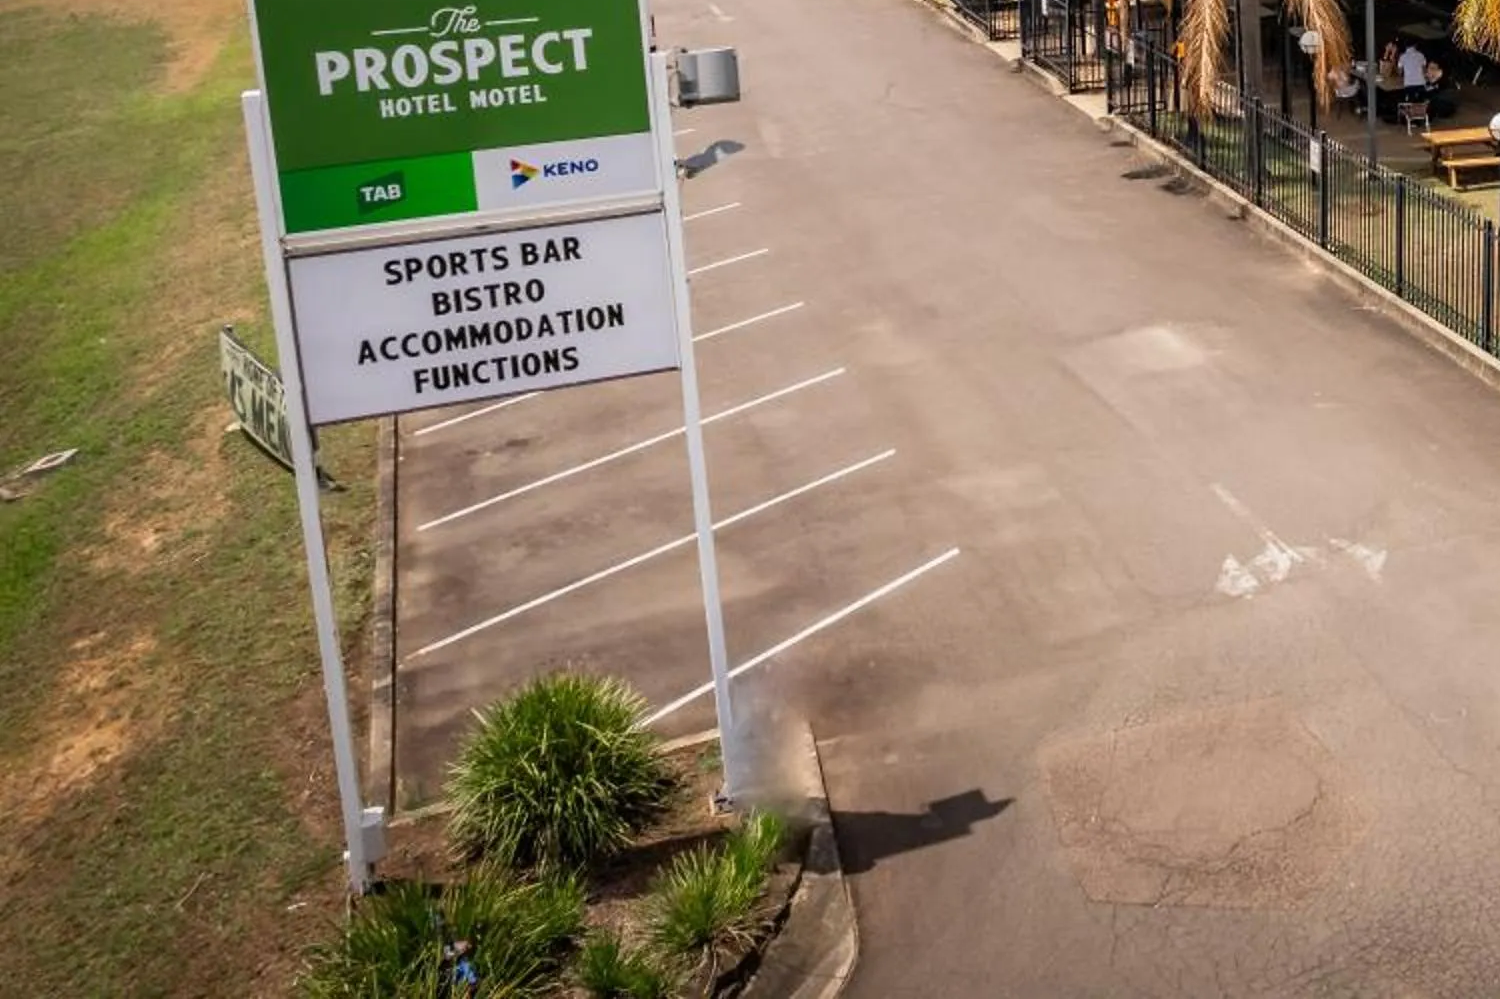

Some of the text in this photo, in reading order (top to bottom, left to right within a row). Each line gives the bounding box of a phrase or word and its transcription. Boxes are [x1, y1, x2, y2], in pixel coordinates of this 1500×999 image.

[430, 5, 481, 37] The
[315, 28, 593, 95] PROSPECT
[381, 84, 547, 119] HOTEL MOTEL
[543, 157, 599, 178] KENO
[361, 184, 402, 203] TAB
[384, 237, 581, 285] SPORTS BAR
[432, 279, 545, 316] BISTRO
[357, 303, 625, 366] ACCOMMODATION
[413, 347, 580, 394] FUNCTIONS
